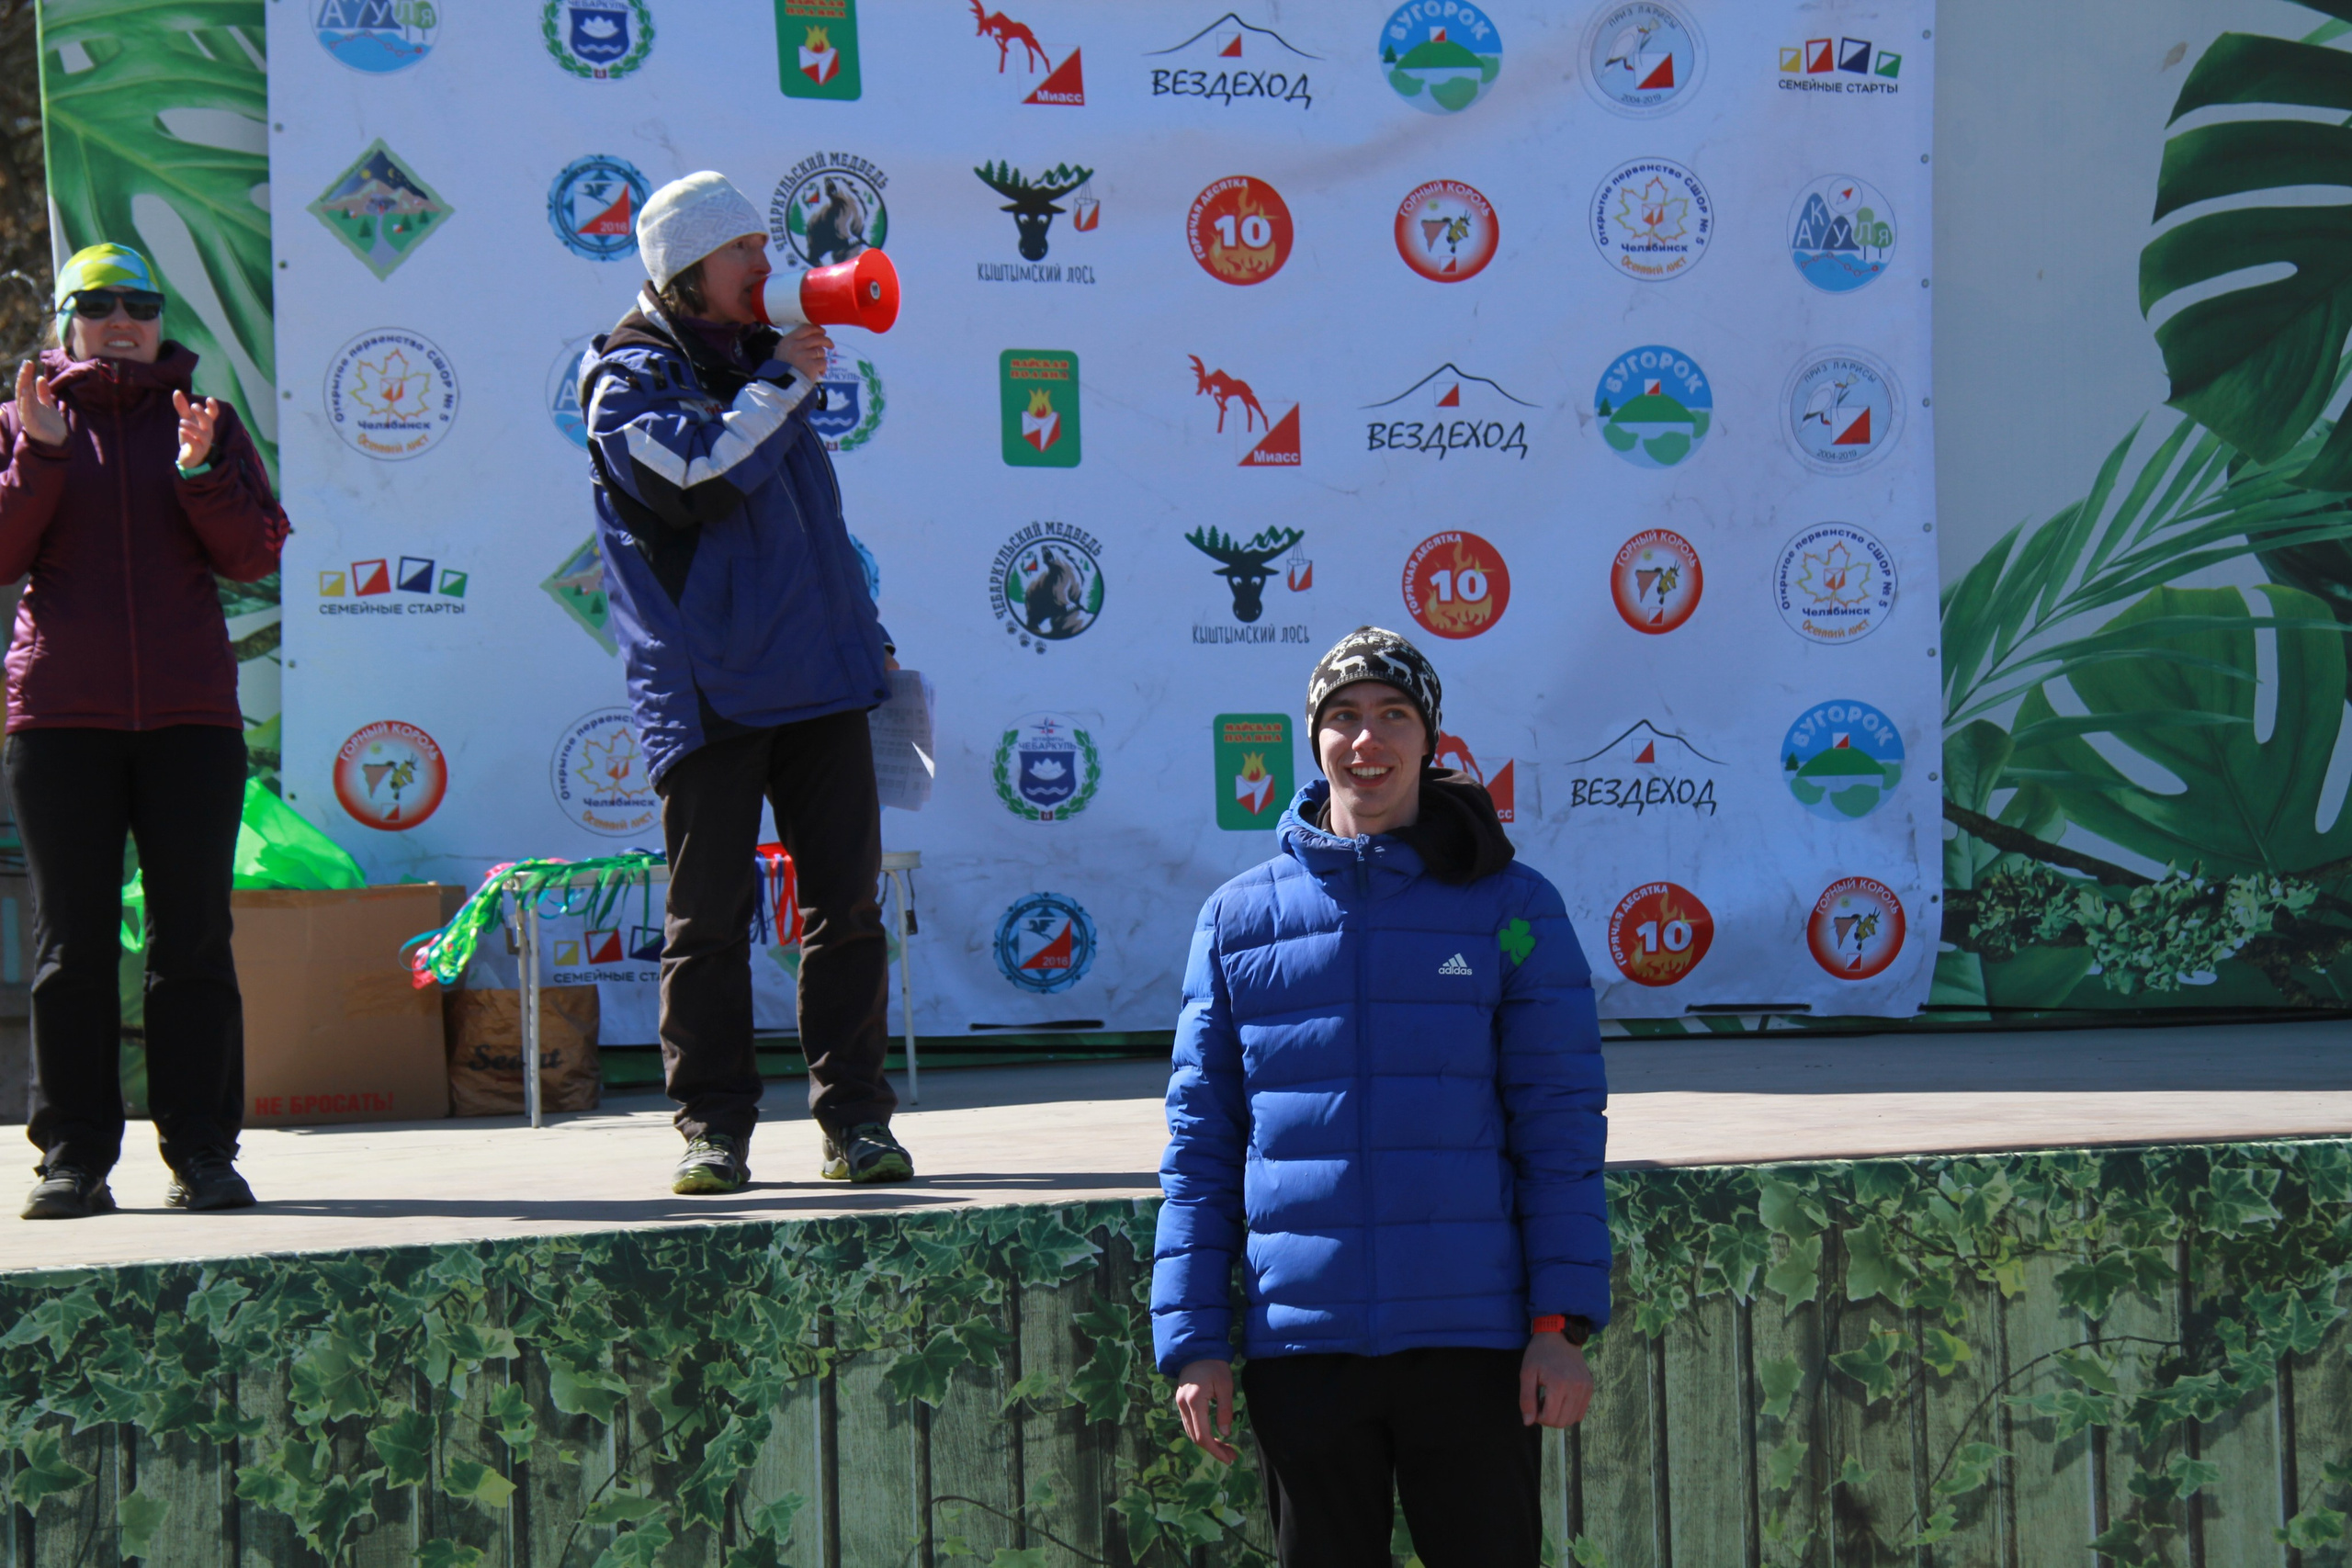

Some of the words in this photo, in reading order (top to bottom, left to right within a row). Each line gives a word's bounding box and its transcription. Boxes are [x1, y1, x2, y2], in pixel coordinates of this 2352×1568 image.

[786, 6, 846, 18] ПОЛЯНА
[1389, 0, 1490, 40] БУГОРОК
[1609, 8, 1633, 28] ПРИЗ
[1036, 89, 1083, 104] Миасс
[1151, 69, 1312, 109] ВЕЗДЕХОД
[1778, 78, 1843, 93] СЕМЕЙНЫЕ
[1847, 82, 1898, 94] СТАРТЫ
[769, 151, 827, 252] ЧЕБАРКУЛЬСКИЙ
[830, 152, 889, 190] МЕДВЕДЬ
[1399, 181, 1443, 217] ГОРНЫЙ
[1447, 182, 1490, 217] КОРОЛЬ
[1596, 186, 1612, 246] Открытое
[1611, 164, 1682, 187] первенство
[1684, 176, 1708, 214] СШОР
[600, 221, 628, 232] 2016
[1189, 204, 1206, 260] ГОРЯЧАЯ
[1200, 177, 1249, 207] ДЕСЯТКА
[1214, 214, 1272, 248] 10
[1621, 243, 1689, 253] Челябинск
[977, 263, 1061, 284] КЫШТЫМСКИЙ
[1067, 265, 1096, 285] ЛОСЬ
[348, 335, 424, 359] первенство
[1011, 357, 1069, 368] МАЙСКАЯ
[1011, 369, 1069, 379] ПОЛЯНА
[1605, 351, 1702, 394] БУГОРОК
[1804, 364, 1827, 383] ПРИЗ
[1834, 361, 1877, 383] ЛАРИСЫ
[356, 420, 431, 430] Челябинск
[1366, 419, 1529, 460] ВЕЗДЕХОД
[1253, 449, 1299, 464] Миасс
[1616, 530, 1657, 568] ГОРНЫЙ
[1660, 531, 1697, 568] КОРОЛЬ
[989, 520, 1043, 621] ЧЕБАРКУЛЬСКИЙ
[1046, 521, 1102, 558] МЕДВЕДЬ
[1405, 560, 1421, 615] ГОРЯЧАЯ
[1415, 533, 1463, 562] ДЕСЯТКА
[1780, 550, 1795, 611] Открытое
[1794, 528, 1865, 550] первенство
[1867, 541, 1891, 577] СШОР
[1430, 569, 1487, 603] 10
[319, 602, 402, 615] СЕМЕЙНЫЕ
[407, 604, 465, 615] СТАРТЫ
[1802, 607, 1871, 616] Челябинск
[1192, 624, 1275, 645] КЫШТЫМСКИЙ
[1281, 625, 1310, 644] ЛОСЬ
[576, 714, 634, 737] первенс
[1224, 722, 1282, 732] МАЙСКАЯ
[1792, 705, 1894, 748] БУГОРОК
[339, 720, 388, 761] ГОРНЫЙ
[391, 723, 439, 761] КОРОЛЬ
[1018, 741, 1077, 750] ЧЕБАРКУЛЬ
[1224, 734, 1282, 742] ПОЛЯНА
[583, 796, 656, 807] Челябинск
[1570, 776, 1717, 817] ВЕЗДЕХОД
[1815, 877, 1856, 915] ГОРНЫЙ
[1860, 878, 1900, 915] КОРОЛЬ
[1611, 911, 1628, 966] ГОРЯЧАЯ
[1622, 885, 1668, 914] ДЕСЯТКА
[1636, 920, 1692, 953] 10
[1042, 956, 1069, 966] 2016
[1438, 965, 1473, 976] adidas
[553, 968, 635, 983] СЕМЕЙНЫЕ
[254, 1096, 283, 1116] НЕ
[289, 1091, 395, 1115] БРОСАТЬ!
